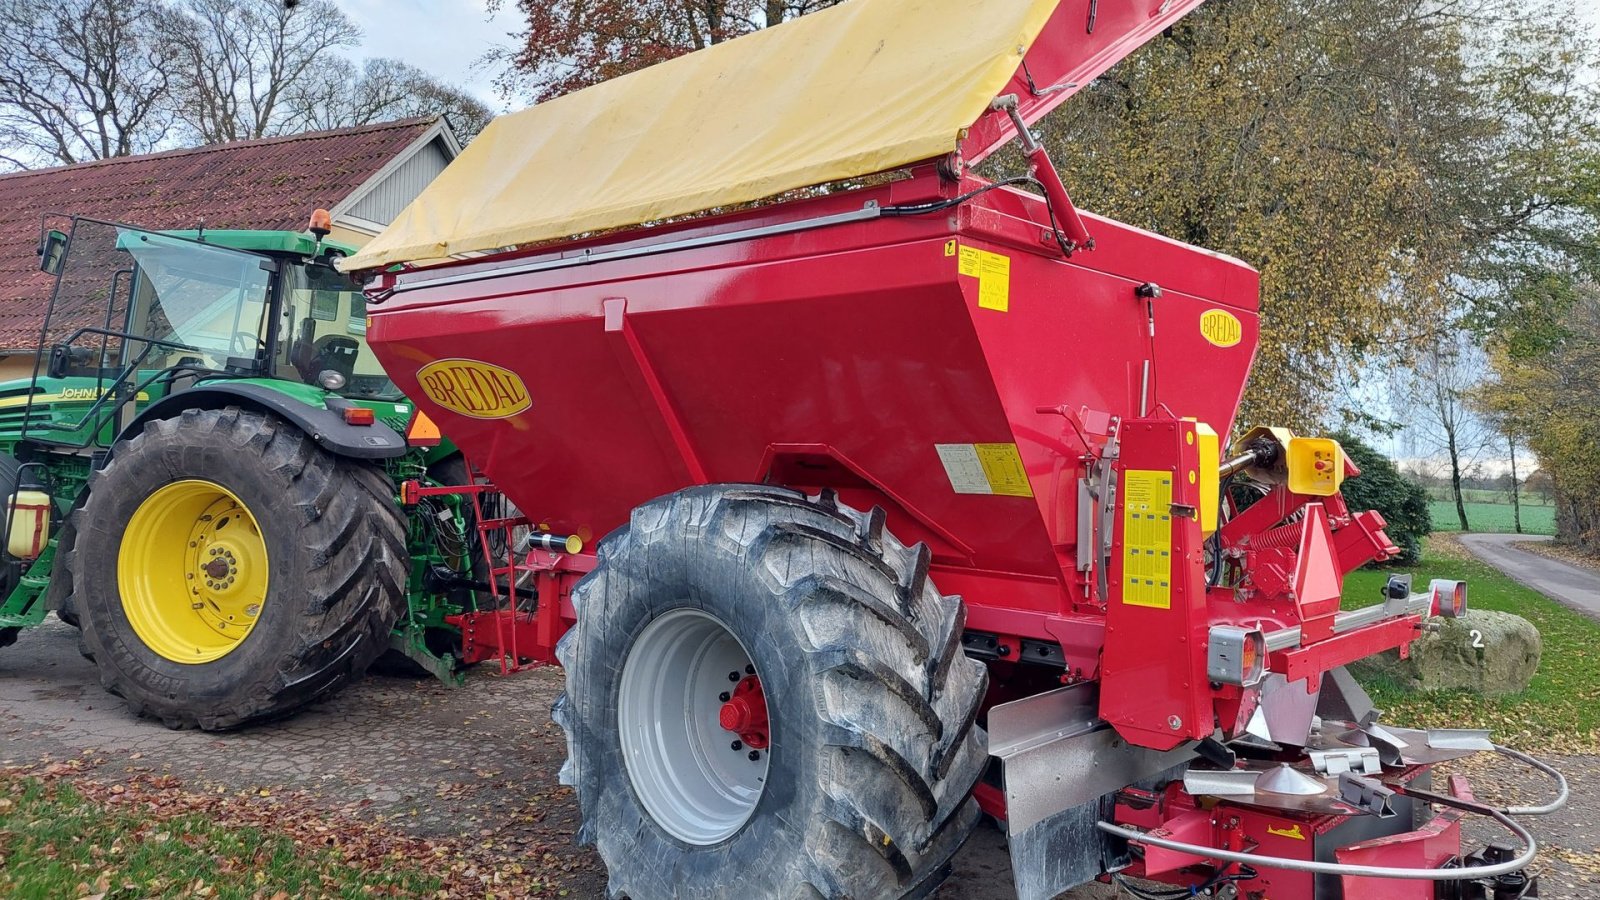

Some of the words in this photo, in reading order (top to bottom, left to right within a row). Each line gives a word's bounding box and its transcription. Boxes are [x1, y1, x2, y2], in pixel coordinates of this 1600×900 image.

[1203, 314, 1240, 342] BREDAL
[59, 387, 92, 399] JOHN
[424, 366, 525, 413] BREDAL
[1470, 630, 1485, 647] 2
